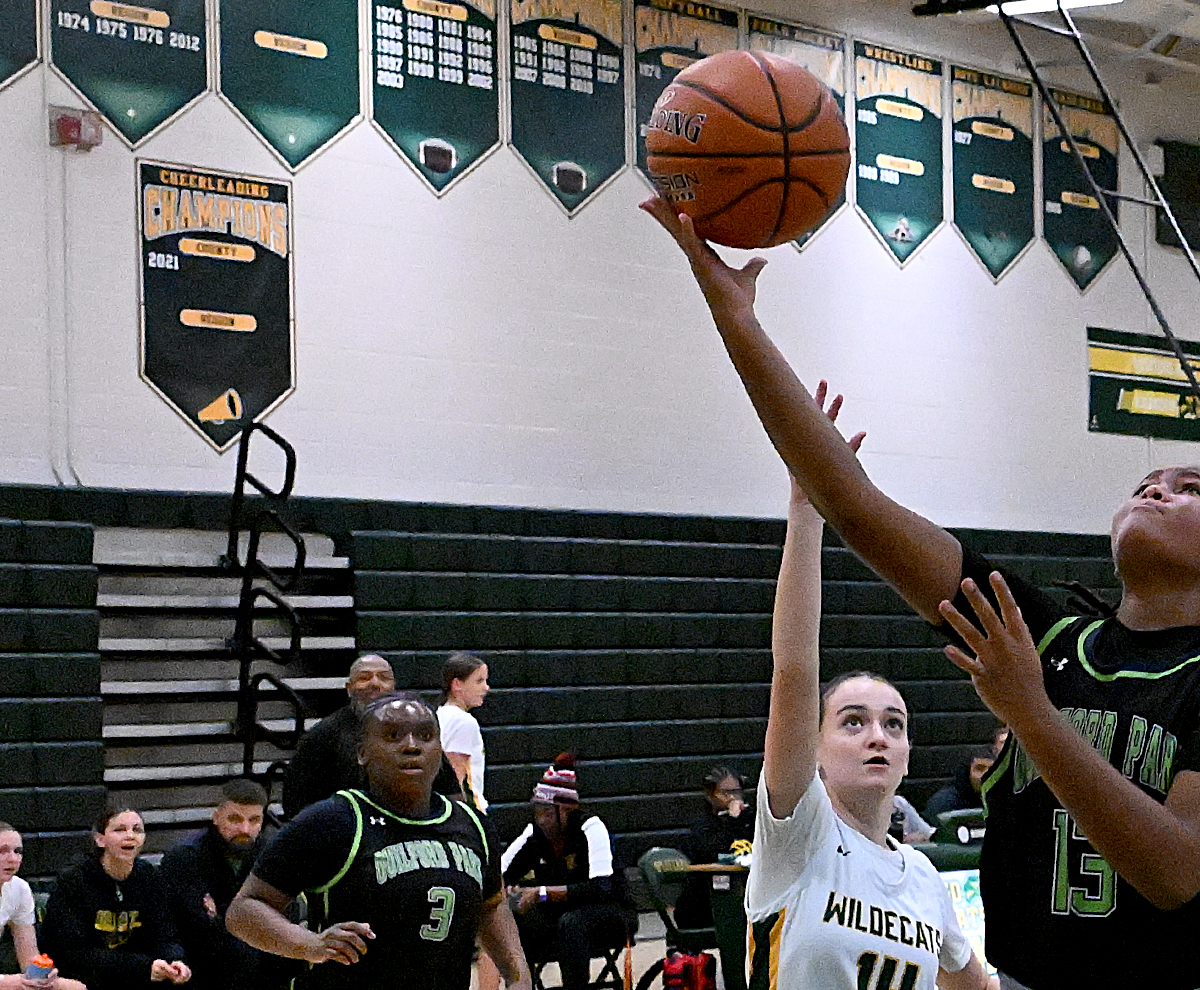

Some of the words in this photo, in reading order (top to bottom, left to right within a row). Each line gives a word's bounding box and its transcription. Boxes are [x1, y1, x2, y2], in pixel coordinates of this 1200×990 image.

[57, 10, 90, 32] 1974
[96, 18, 127, 39] 1975
[133, 25, 163, 45] 1976
[169, 31, 200, 52] 2012
[160, 169, 269, 198] CHEERLEADING
[145, 184, 287, 258] CHAMPIONS
[148, 252, 179, 270] 2021
[1051, 808, 1118, 918] 13
[419, 886, 455, 941] 3
[823, 891, 943, 957] WILDECATS
